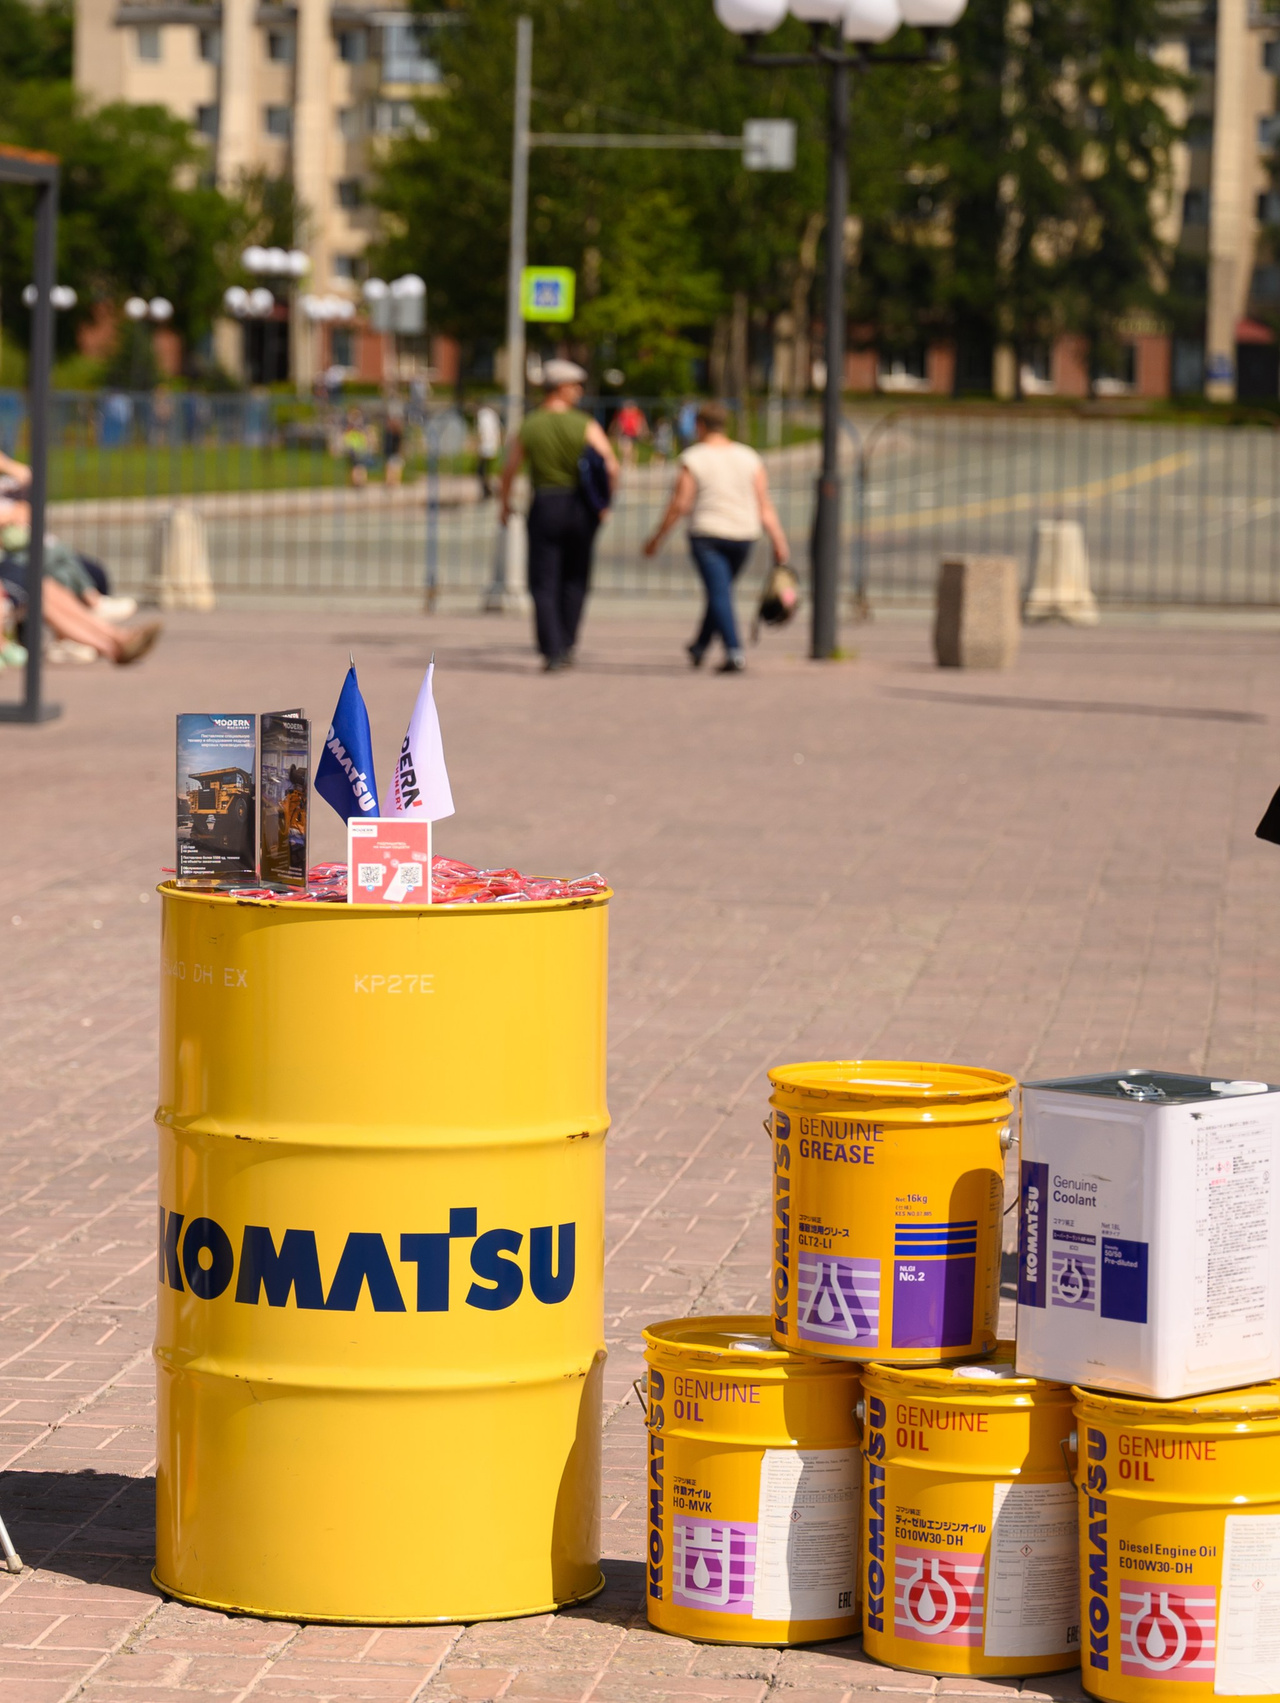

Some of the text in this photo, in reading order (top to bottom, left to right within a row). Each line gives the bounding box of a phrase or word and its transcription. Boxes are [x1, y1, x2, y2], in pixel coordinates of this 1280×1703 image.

[213, 719, 250, 727] MODERN
[193, 963, 214, 985] DH
[223, 967, 248, 988] EX
[354, 973, 435, 994] KP27E
[799, 1116, 885, 1142] GENUINE
[799, 1140, 875, 1165] GREASE
[1053, 1175, 1098, 1193] Genuine
[907, 1194, 928, 1204] 16kg
[1053, 1190, 1097, 1208] Coolant
[773, 1109, 791, 1336] KOMATSU
[798, 1234, 832, 1249] GLT2-LI
[1026, 1186, 1040, 1283] KOMATSU
[158, 1206, 576, 1313] KOMATSU
[1104, 1250, 1122, 1258] 50/50
[1104, 1257, 1138, 1268] Pre-diluted
[899, 1272, 925, 1282] No.2
[673, 1376, 761, 1404] GENUINE
[673, 1402, 704, 1423] OIL
[896, 1404, 989, 1433] GENUINE
[896, 1428, 929, 1452] OIL
[1119, 1434, 1217, 1462] GENUINE
[1119, 1459, 1155, 1482] OIL
[645, 1368, 666, 1601] KOMATSU
[673, 1485, 712, 1499] 作動オイル
[673, 1496, 713, 1513] HO-MVK
[863, 1395, 887, 1634] KOMATSU
[895, 1514, 986, 1534] ディーゼルエンジンオイル
[1081, 1427, 1110, 1671] KOMATSU
[1119, 1539, 1217, 1559] Diesel Engine Oil
